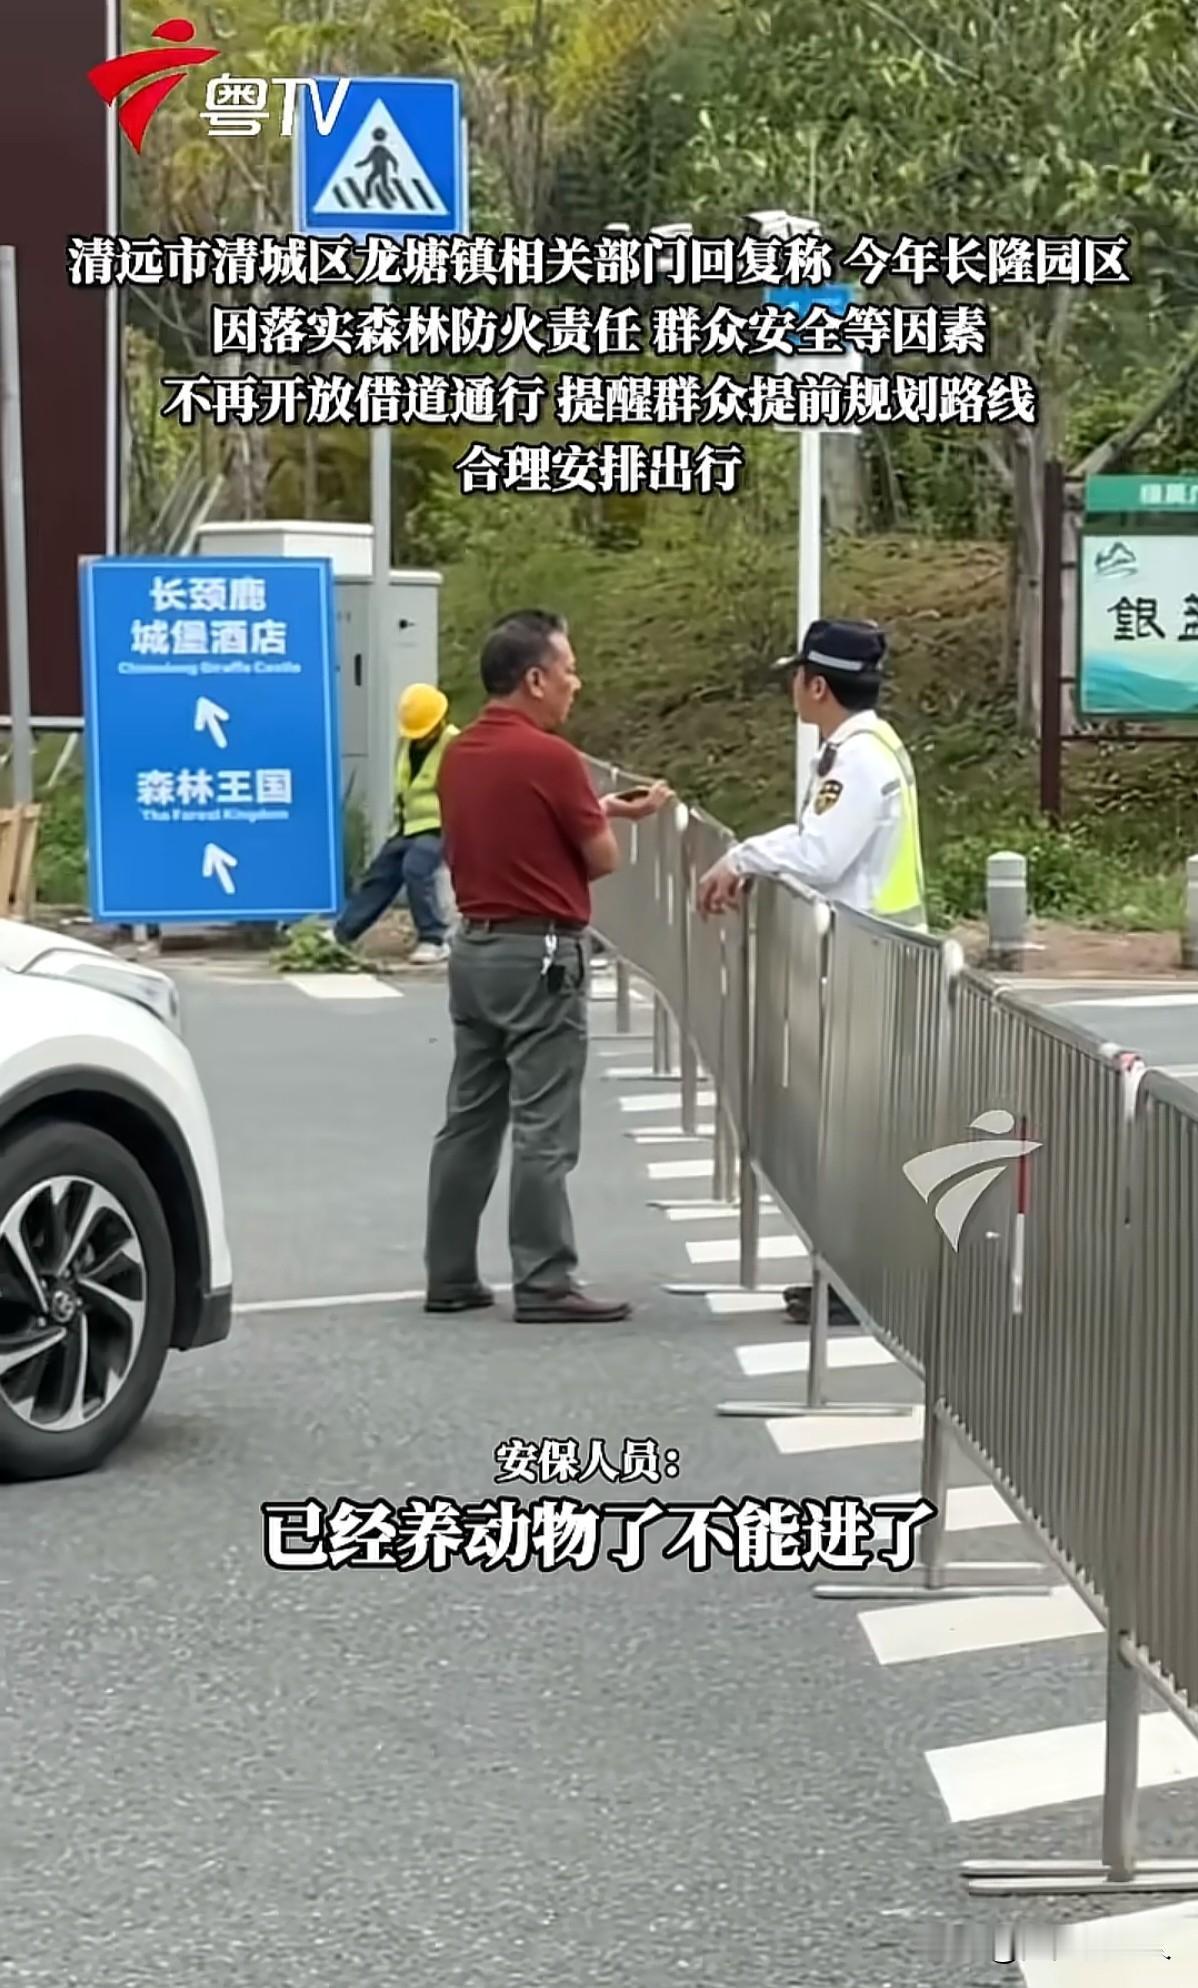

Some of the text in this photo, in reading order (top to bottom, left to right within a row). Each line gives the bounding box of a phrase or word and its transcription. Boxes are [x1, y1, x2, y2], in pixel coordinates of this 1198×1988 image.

[149, 575, 267, 613] 长颈鹿
[130, 619, 288, 656] 城堡酒店
[136, 768, 293, 806] 森林王国
